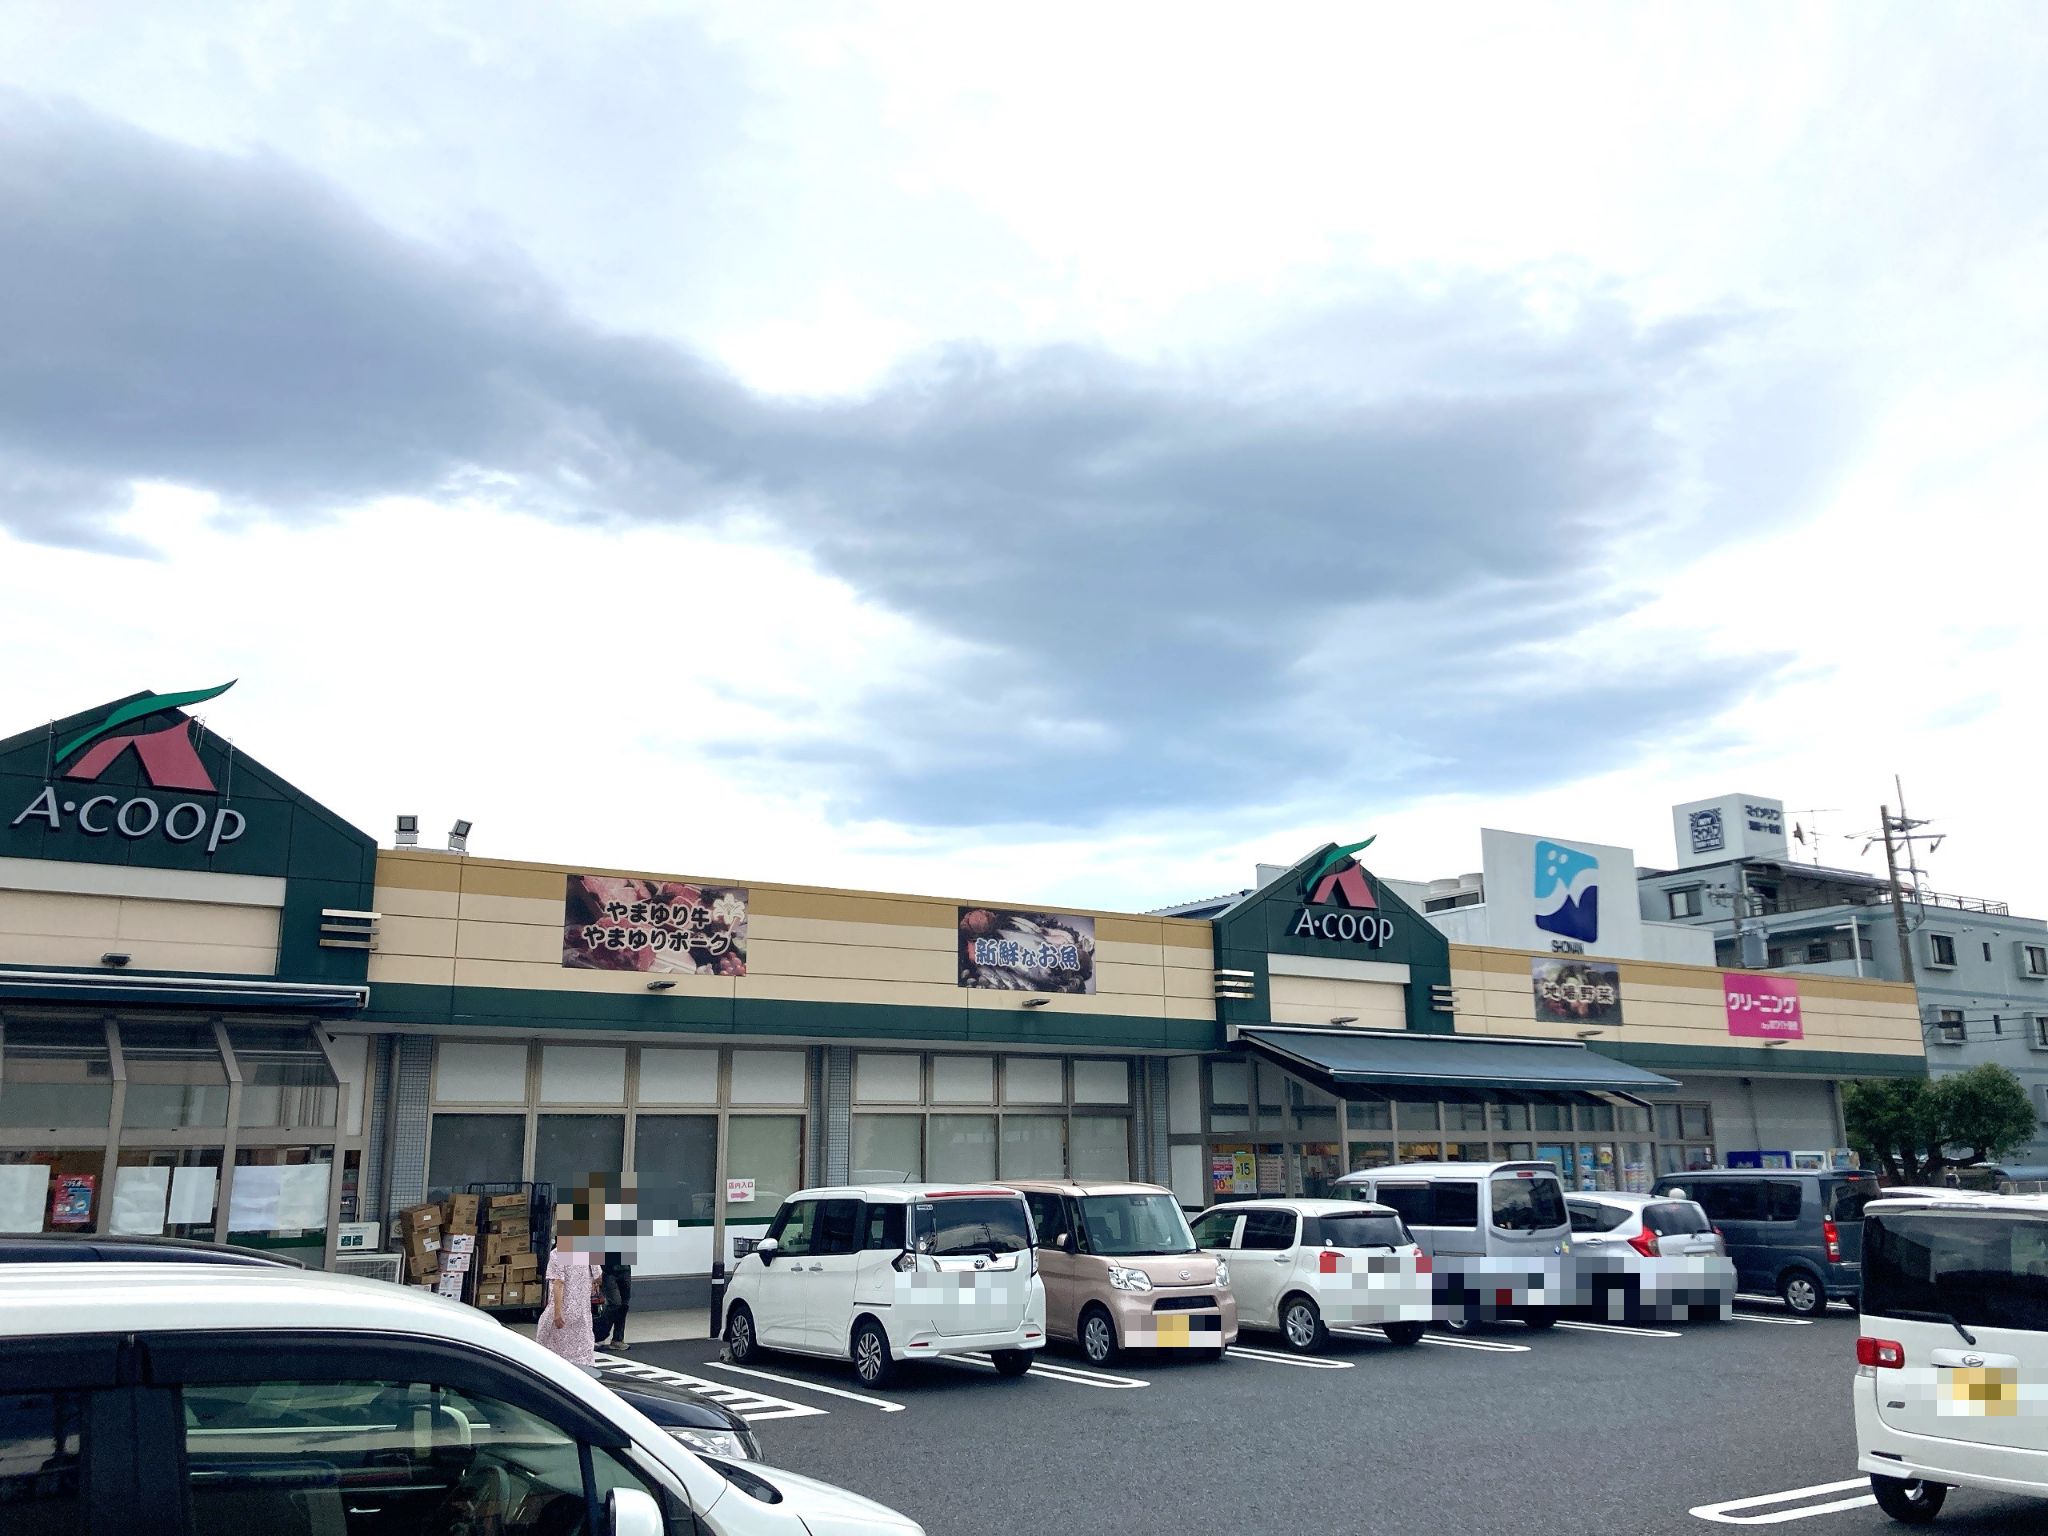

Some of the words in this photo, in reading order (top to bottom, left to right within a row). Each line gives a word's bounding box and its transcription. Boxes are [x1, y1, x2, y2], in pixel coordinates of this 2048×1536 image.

[607, 901, 711, 929] やまゆり牛
[583, 926, 730, 955] やまゆりポーク
[975, 938, 1080, 971] 新鮮なお魚
[1542, 982, 1615, 1005] 地場野菜
[1727, 992, 1797, 1014] クリーニング
[728, 1181, 754, 1189] 店内入口
